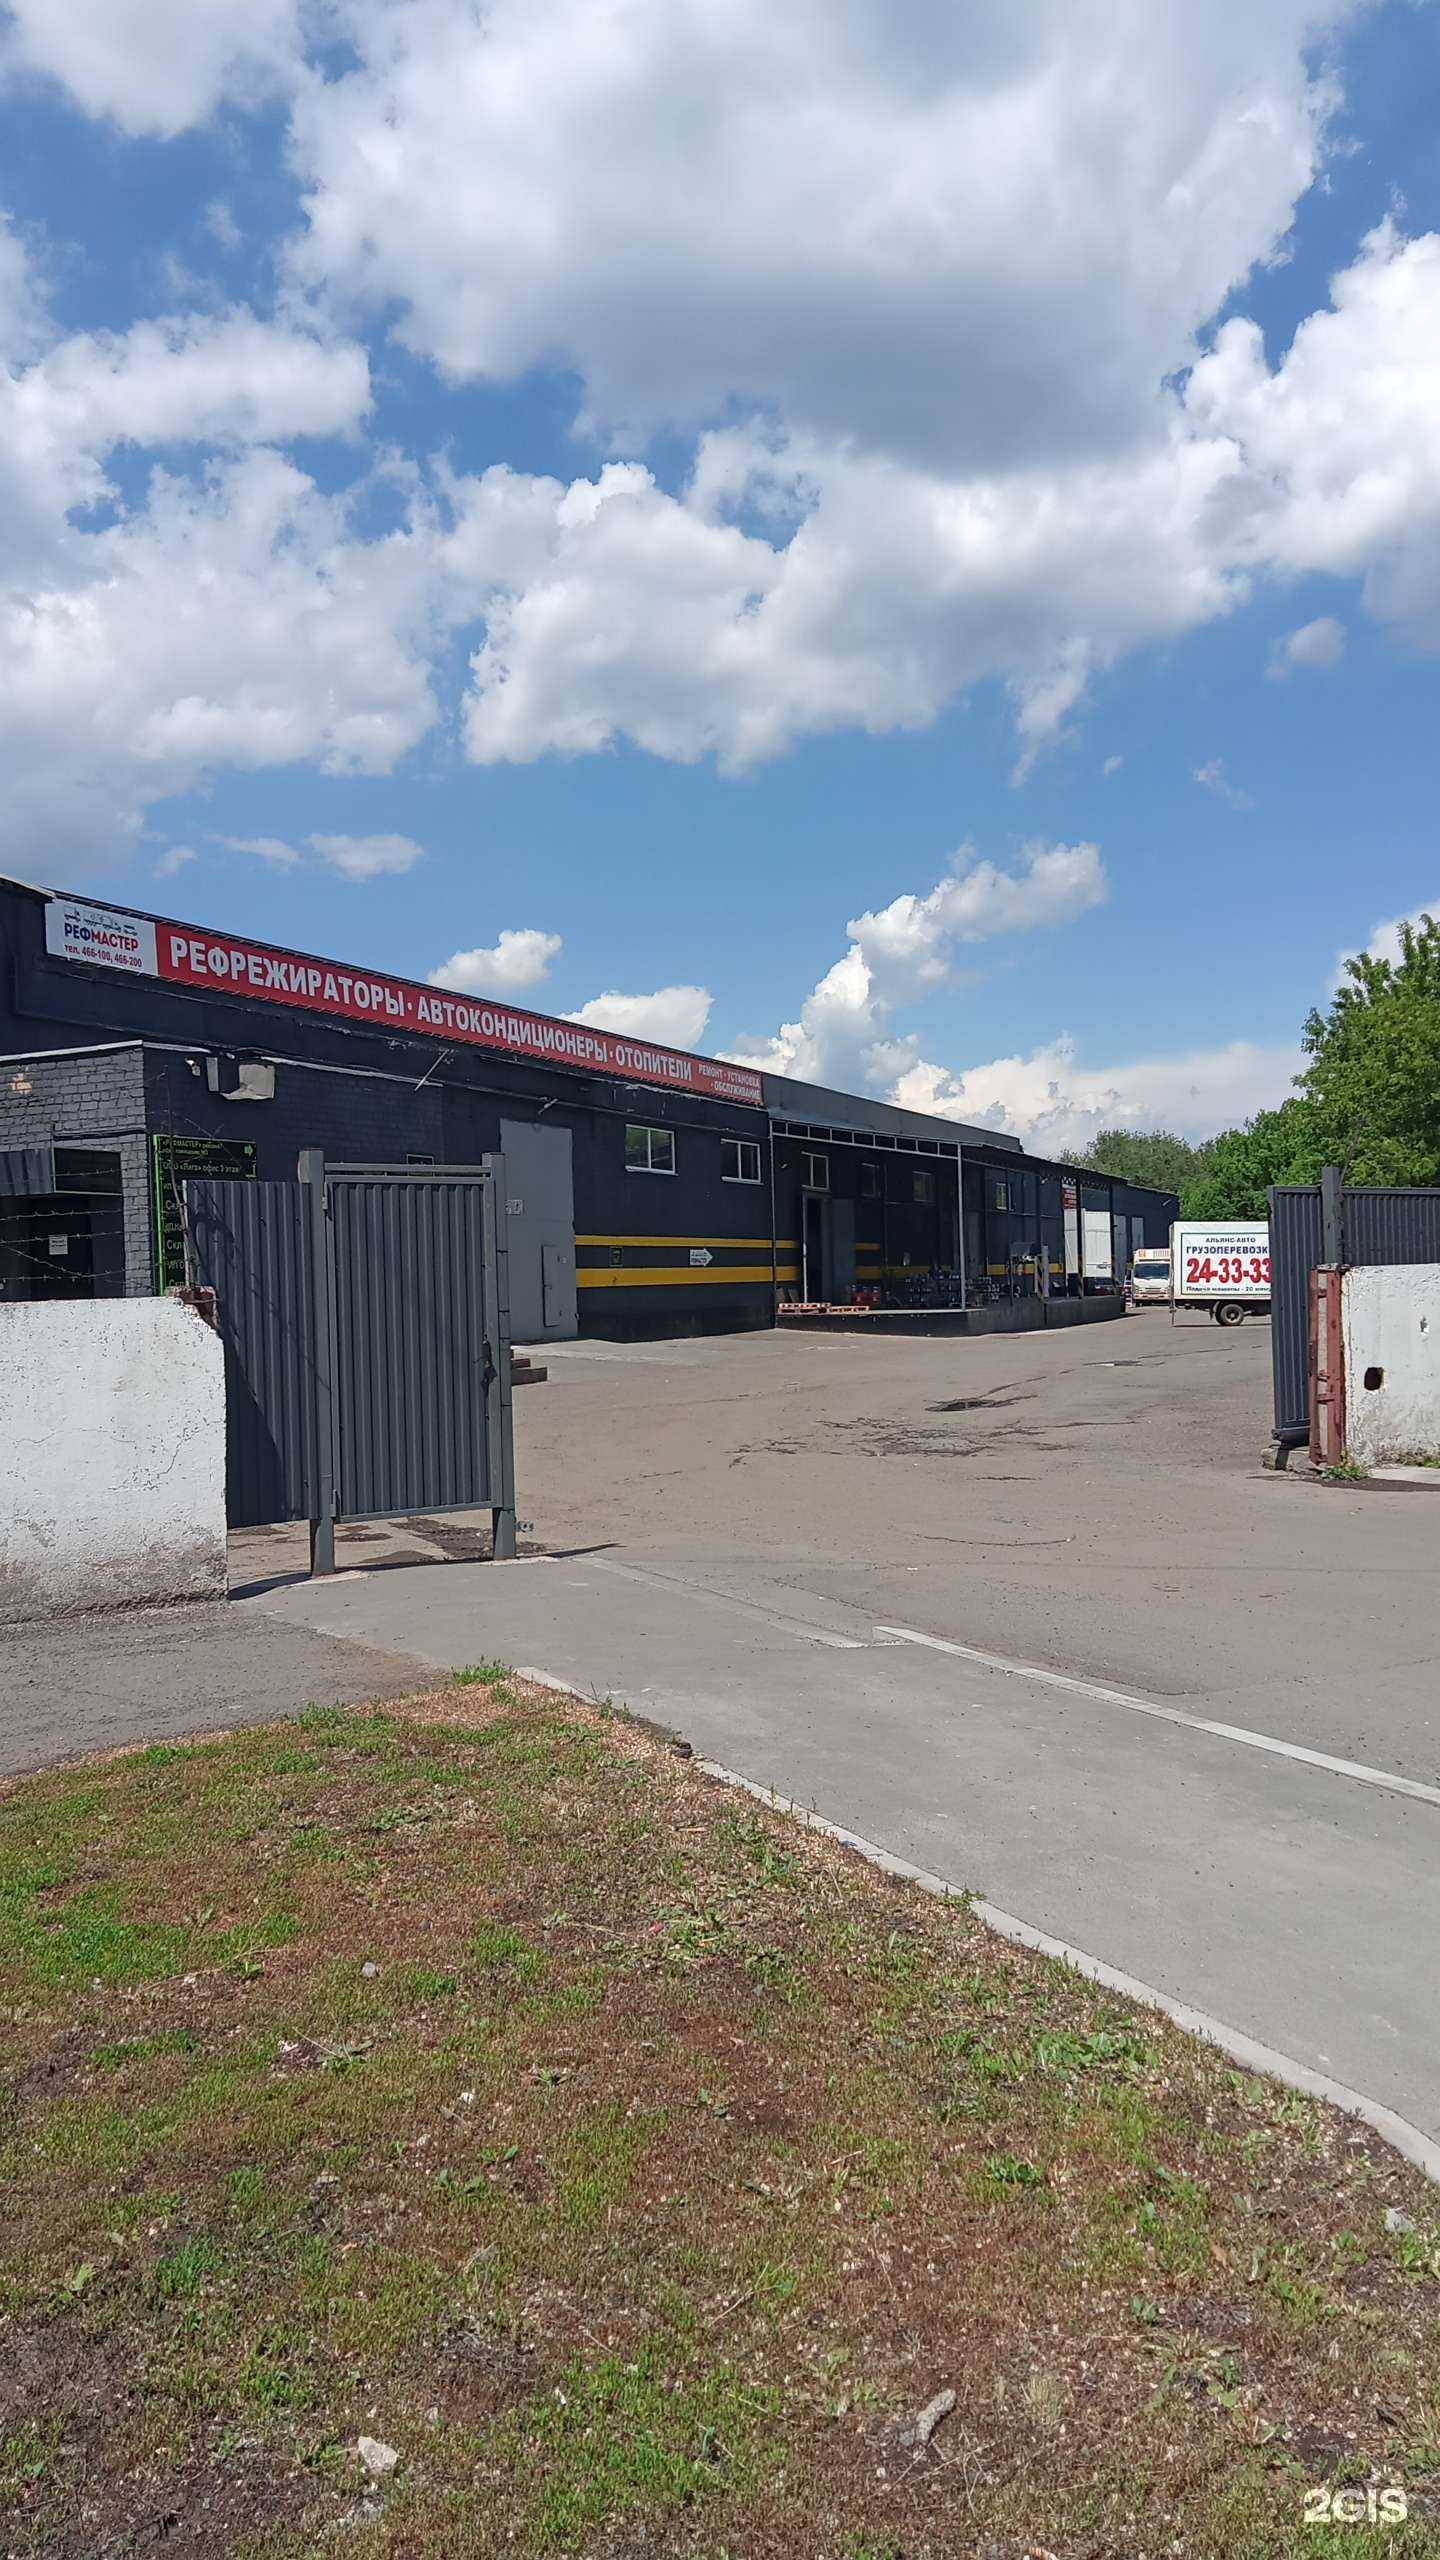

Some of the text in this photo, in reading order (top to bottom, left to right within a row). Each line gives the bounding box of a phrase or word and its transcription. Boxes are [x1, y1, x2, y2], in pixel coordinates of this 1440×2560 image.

[64, 922, 139, 951] РЕФМАСТЕР
[64, 944, 143, 968] тел. 466-100, 466-200
[170, 935, 693, 1081] РЕФРЕЖИРАТОРЫ АВТОКОНДИЦИОНЕРЫ ОТОПИТЕЛИ
[698, 1063, 723, 1079] РЕМОНТ
[1186, 1246, 1268, 1255] ГРУЗОПЕРЕВОЗК
[1186, 1258, 1272, 1283] 24-33-33
